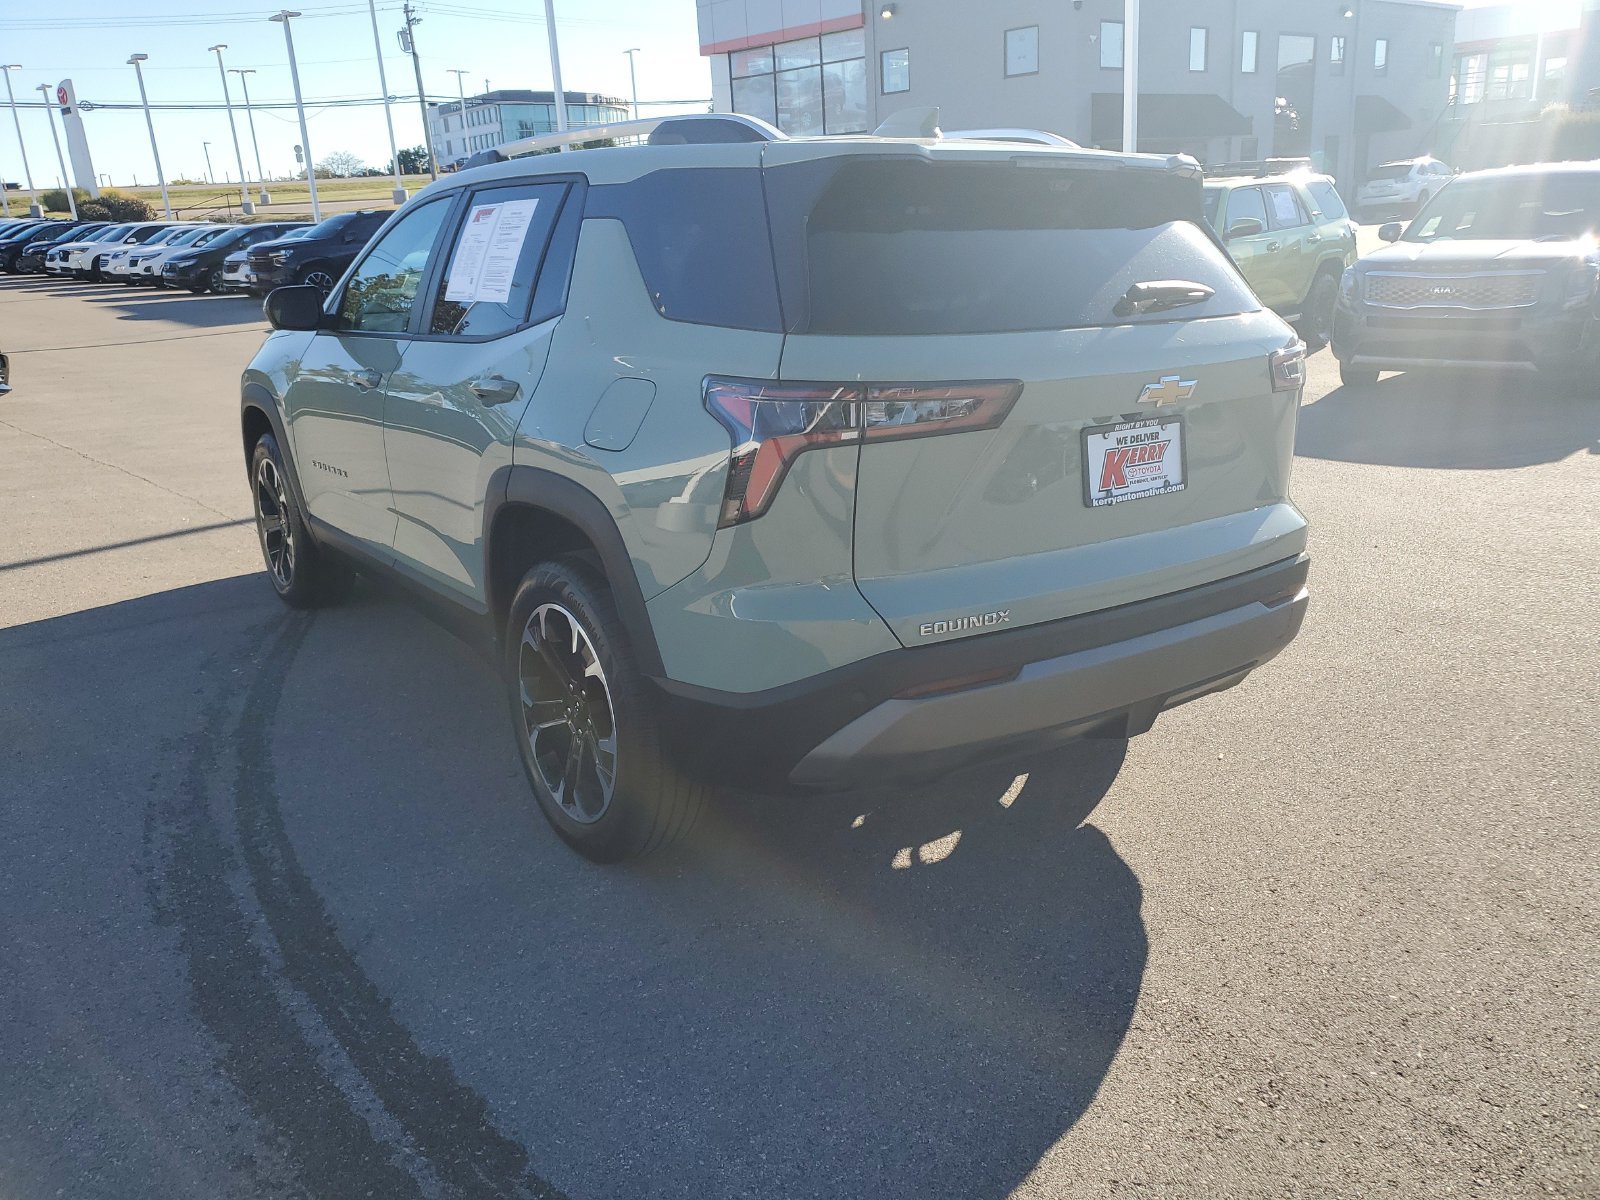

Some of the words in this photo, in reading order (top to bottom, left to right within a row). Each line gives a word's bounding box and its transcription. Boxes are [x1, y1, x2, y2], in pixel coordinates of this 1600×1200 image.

[1114, 422, 1135, 432] RIGHT
[1135, 420, 1145, 428] BY
[1146, 419, 1159, 427] YOU
[1116, 436, 1128, 446] WE
[1130, 431, 1160, 443] DELIVER
[1099, 440, 1171, 491] KERRY
[1137, 465, 1161, 474] TOYOTA
[1092, 483, 1185, 507] kerryautomotive.com
[920, 609, 1010, 636] EQUINOX
